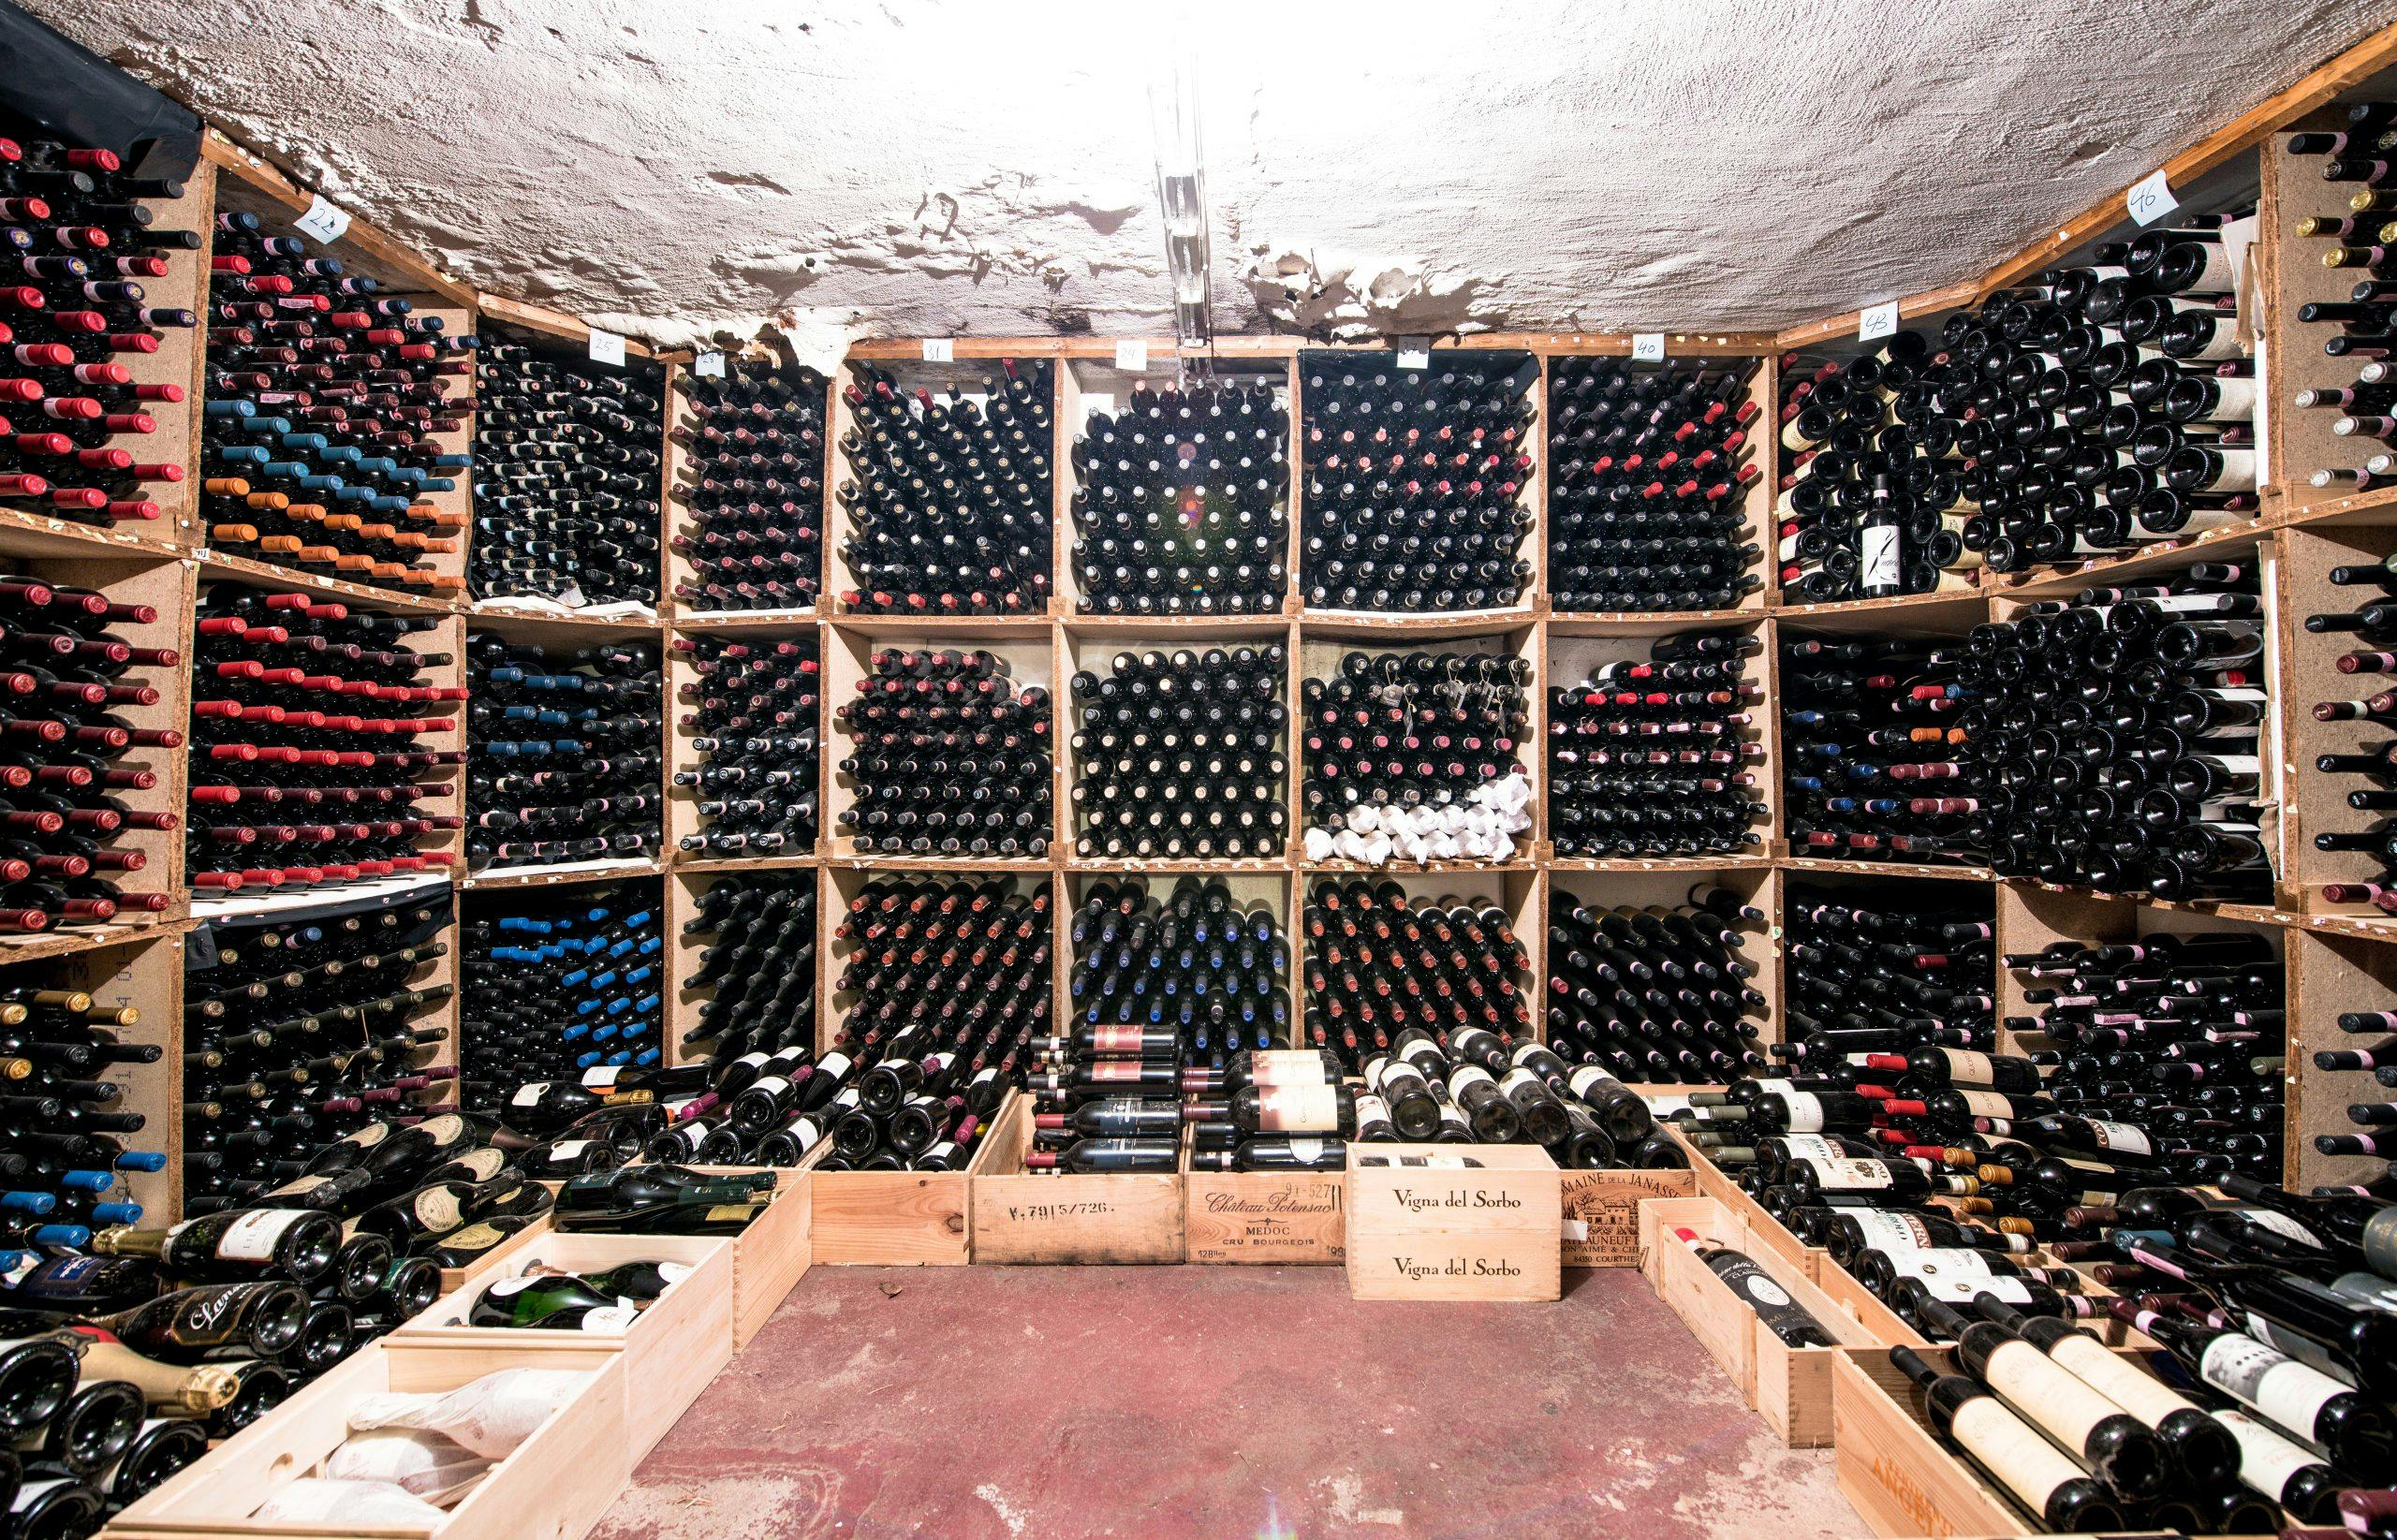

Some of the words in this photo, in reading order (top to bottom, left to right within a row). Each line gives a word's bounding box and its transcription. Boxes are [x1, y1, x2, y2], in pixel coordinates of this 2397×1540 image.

[2130, 181, 2156, 213] 46
[309, 208, 335, 234] 22
[1865, 313, 1888, 333] 43
[595, 338, 614, 352] 25
[928, 345, 940, 359] 31
[1639, 341, 1655, 354] 40
[1561, 1172, 1605, 1198] MAINE
[1205, 1193, 1265, 1214] Château
[1266, 1191, 1332, 1214] Potensac
[1392, 1189, 1439, 1212] Vigna
[1445, 1190, 1467, 1208] del
[1473, 1190, 1522, 1209] Sorbo
[1245, 1226, 1291, 1236] MEDOC
[1561, 1235, 1633, 1245] AAUNEUF
[1581, 1244, 1607, 1254] AIMÉ
[1392, 1256, 1439, 1281] Vigna
[1445, 1258, 1467, 1276] del
[1473, 1258, 1522, 1277] Sorbo
